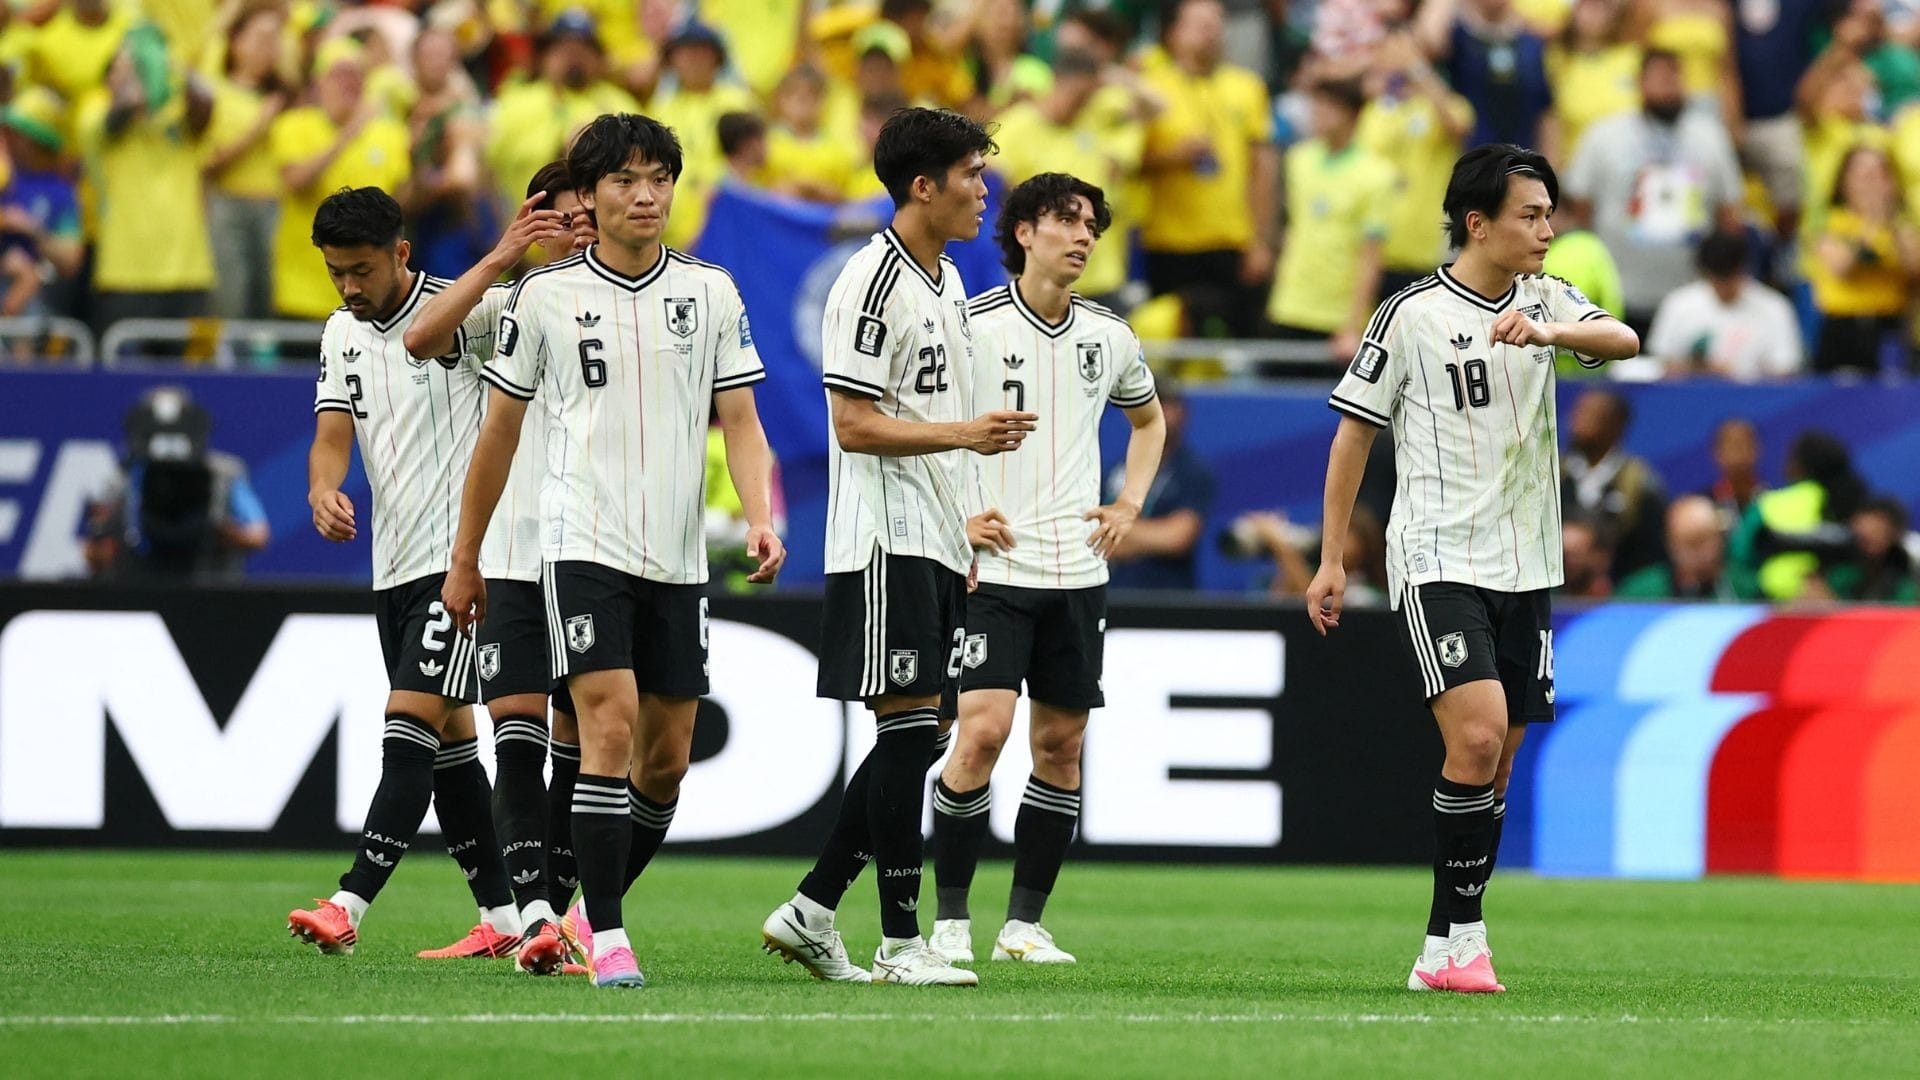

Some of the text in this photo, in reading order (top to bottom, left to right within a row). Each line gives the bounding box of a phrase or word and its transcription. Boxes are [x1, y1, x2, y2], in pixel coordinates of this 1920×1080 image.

[578, 338, 607, 389] 6
[914, 343, 948, 395] 22
[1445, 358, 1490, 411] 18
[345, 374, 368, 419] 2
[1003, 380, 1024, 412] 7
[421, 600, 452, 652] 2
[365, 830, 410, 850] JAPAN
[502, 840, 542, 857] JAPAN
[1445, 855, 1488, 868] JAPAN
